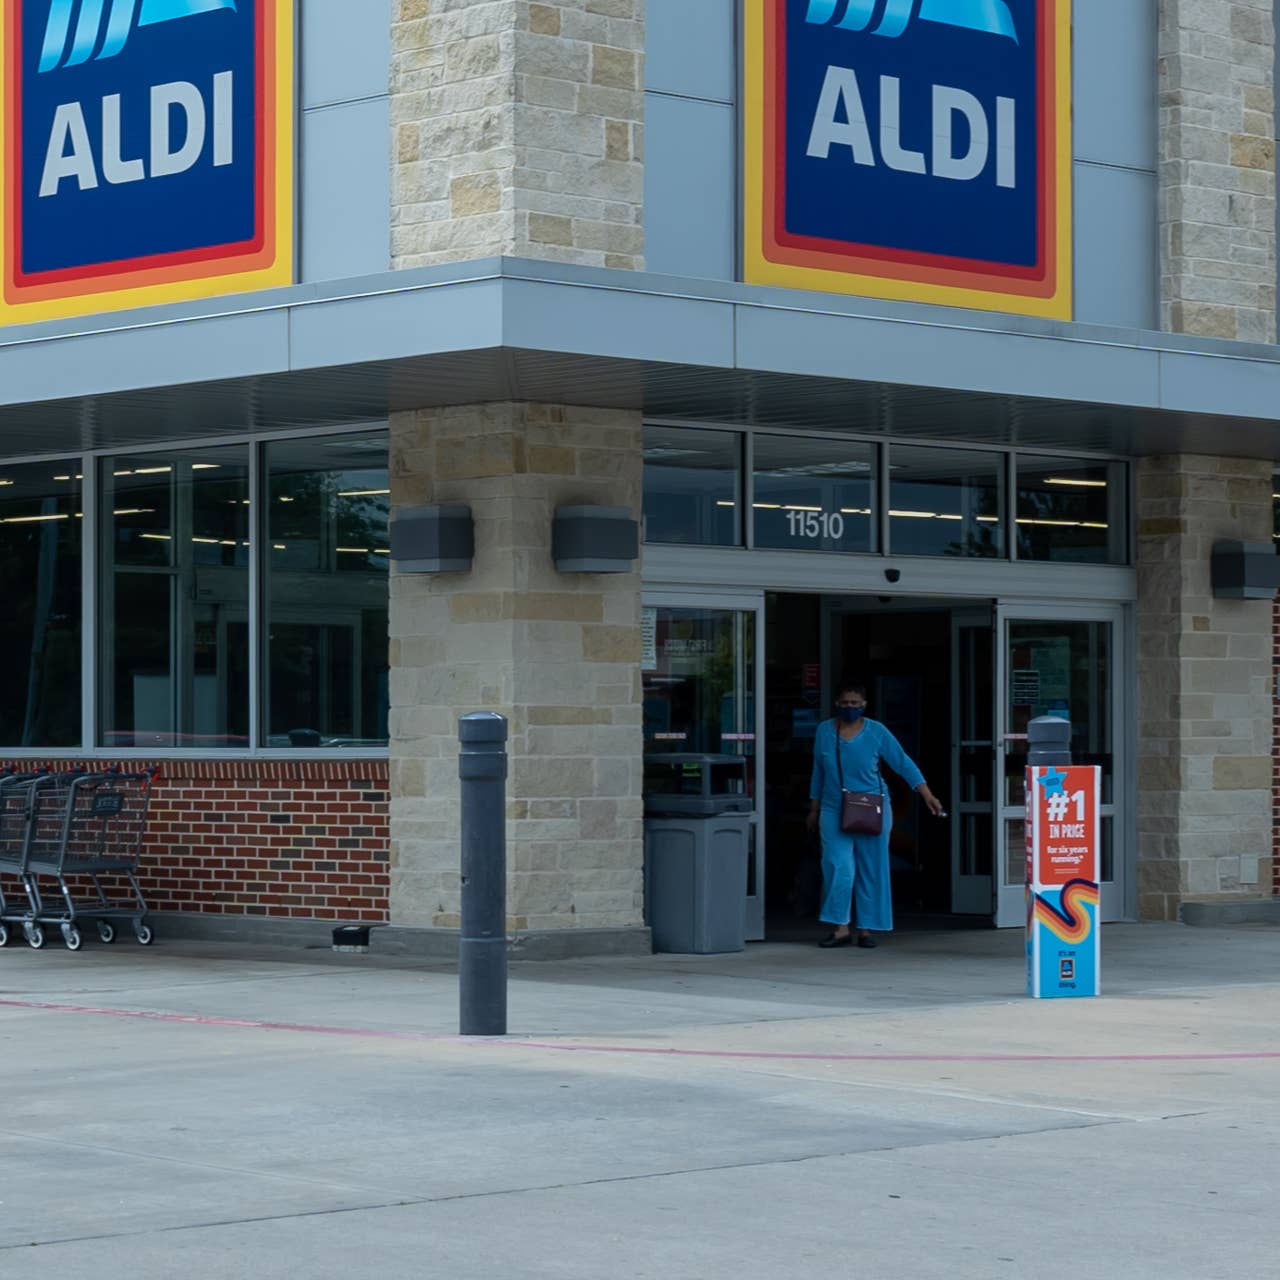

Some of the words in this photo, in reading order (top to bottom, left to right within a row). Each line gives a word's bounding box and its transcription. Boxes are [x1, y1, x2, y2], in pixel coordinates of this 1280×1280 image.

[38, 69, 234, 198] ALDI
[805, 64, 1016, 189] ALDI
[785, 510, 845, 540] 11510
[1046, 790, 1085, 821] #1
